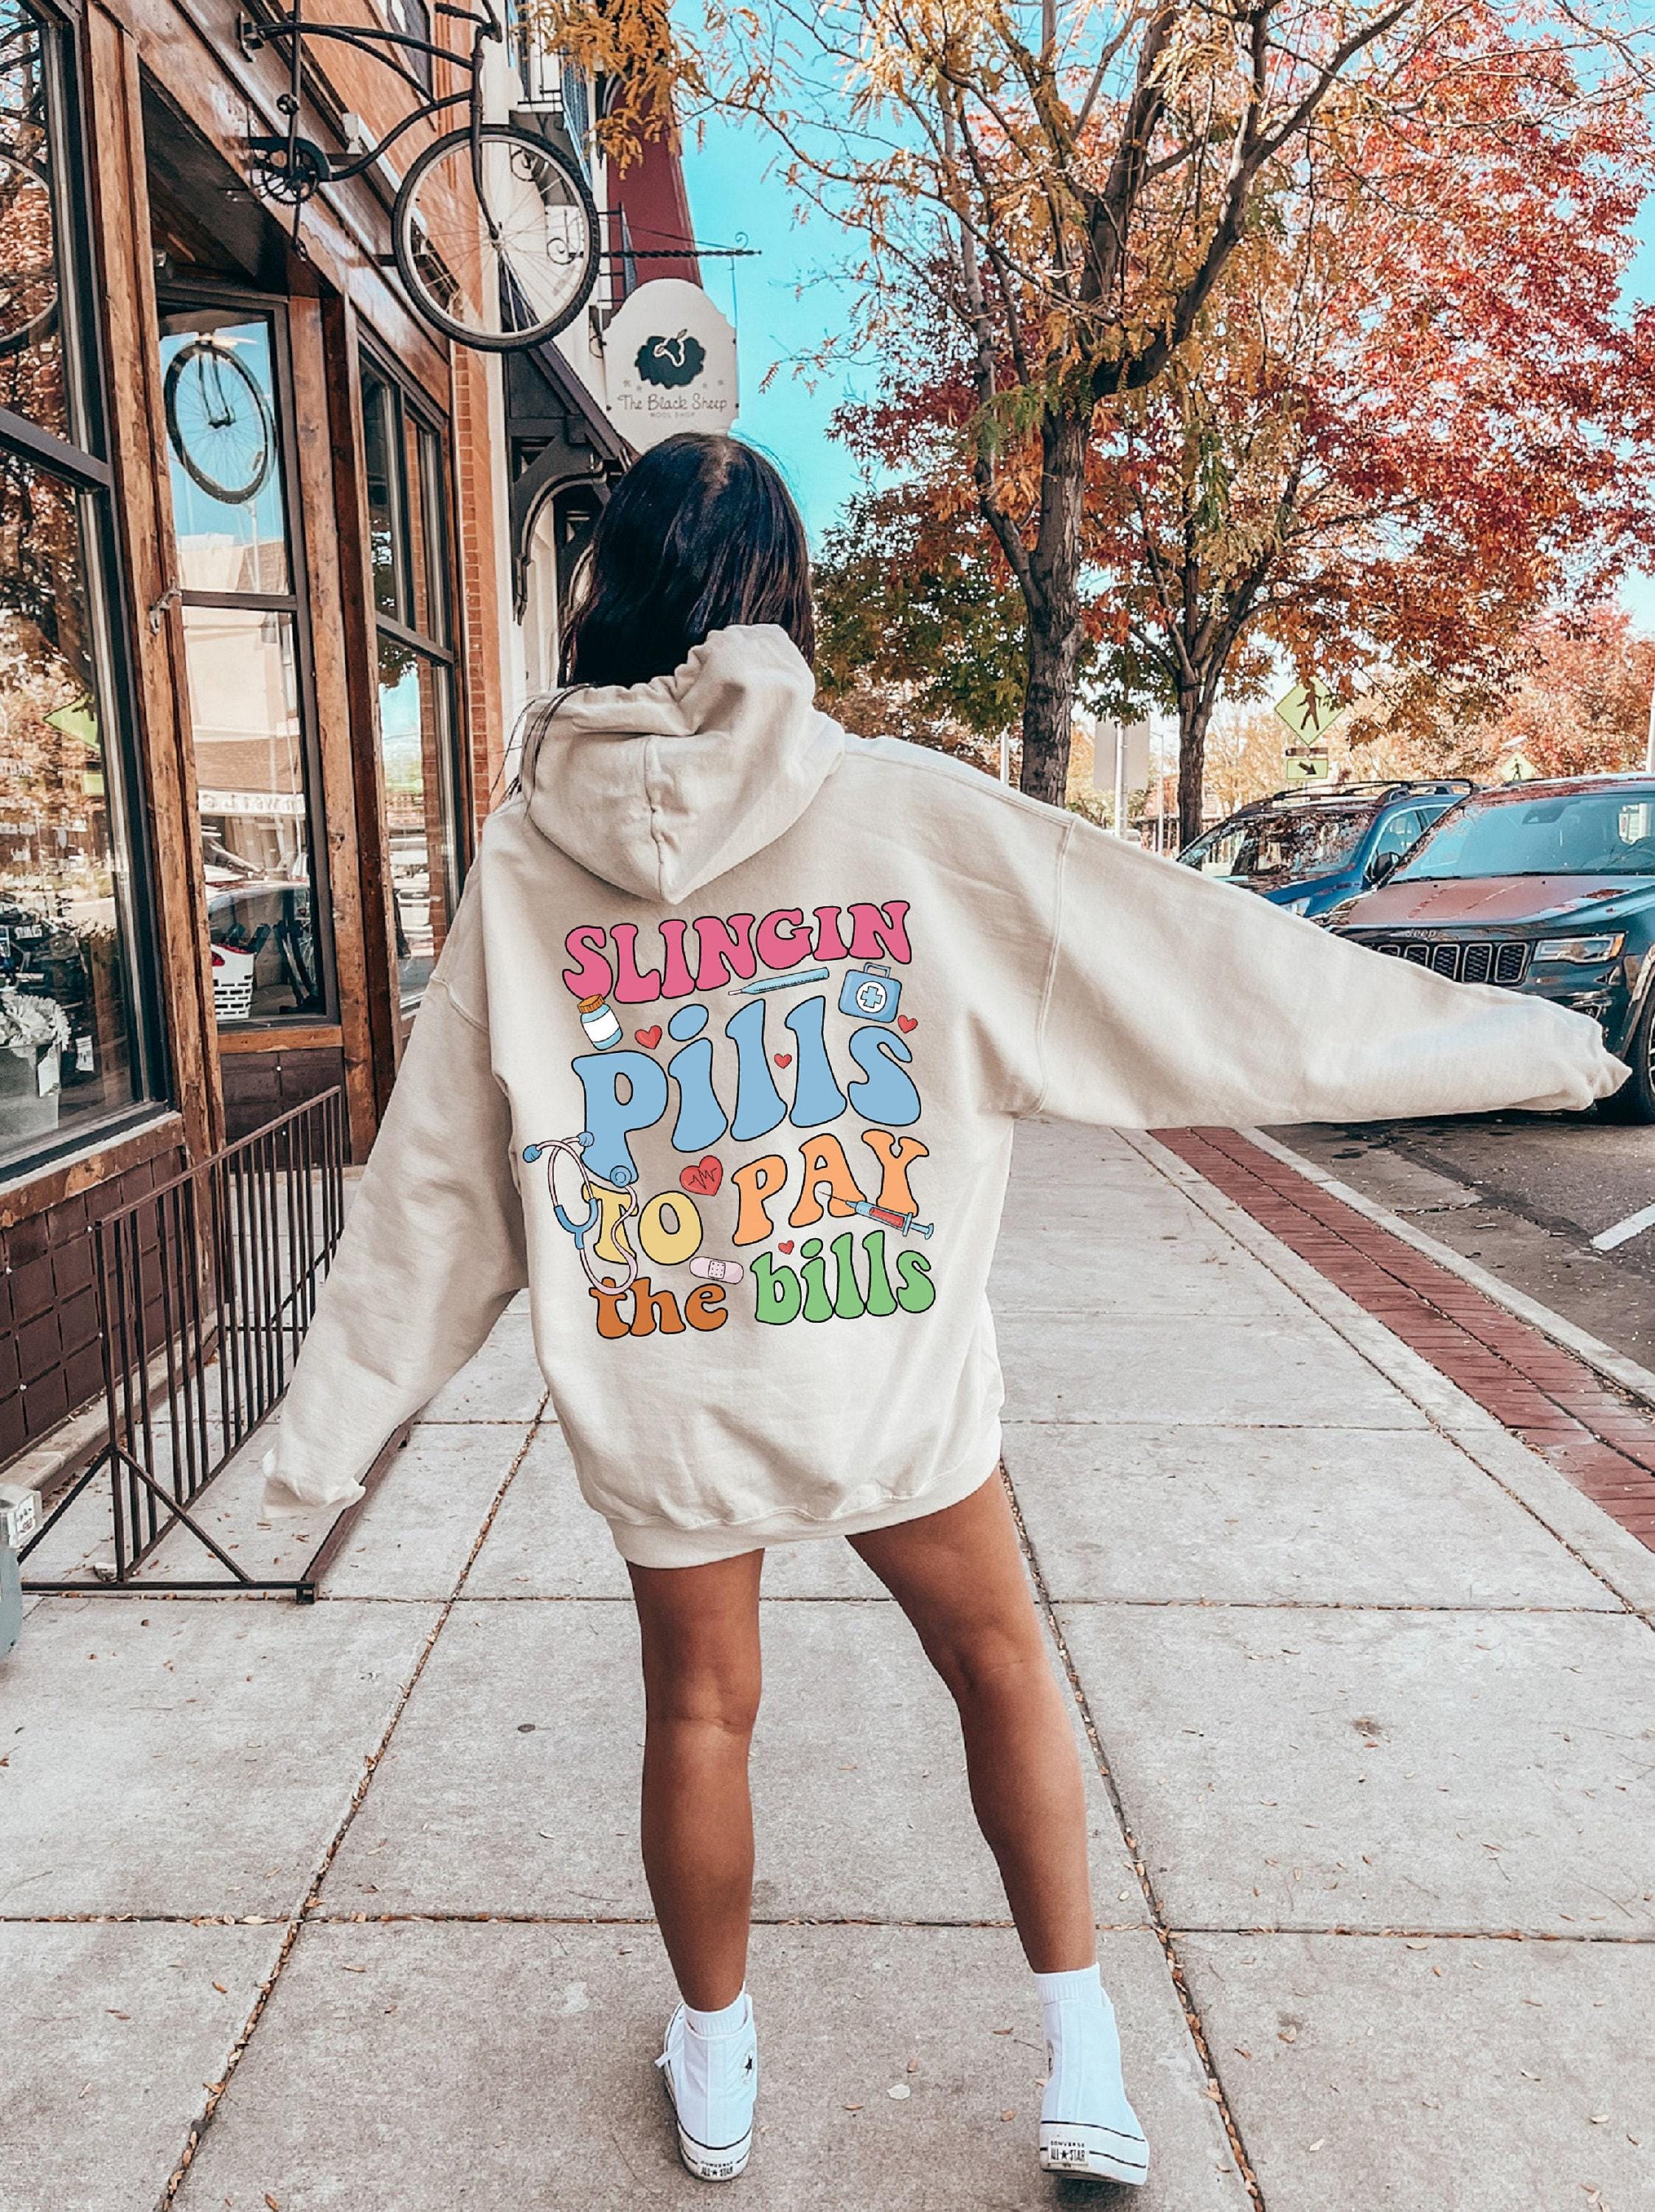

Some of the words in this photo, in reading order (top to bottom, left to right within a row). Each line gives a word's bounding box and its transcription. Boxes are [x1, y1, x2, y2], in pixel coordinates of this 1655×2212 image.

[617, 394, 642, 410] The
[648, 393, 687, 411] Black
[693, 392, 727, 412] Sheep
[562, 900, 912, 1004] SLINGIN
[581, 1181, 704, 1266] TO
[731, 1130, 930, 1246] PAY
[589, 1276, 729, 1340] the
[750, 1230, 937, 1326] bills
[1050, 2149, 1059, 2160] ALL
[1070, 2149, 1086, 2161] STAR
